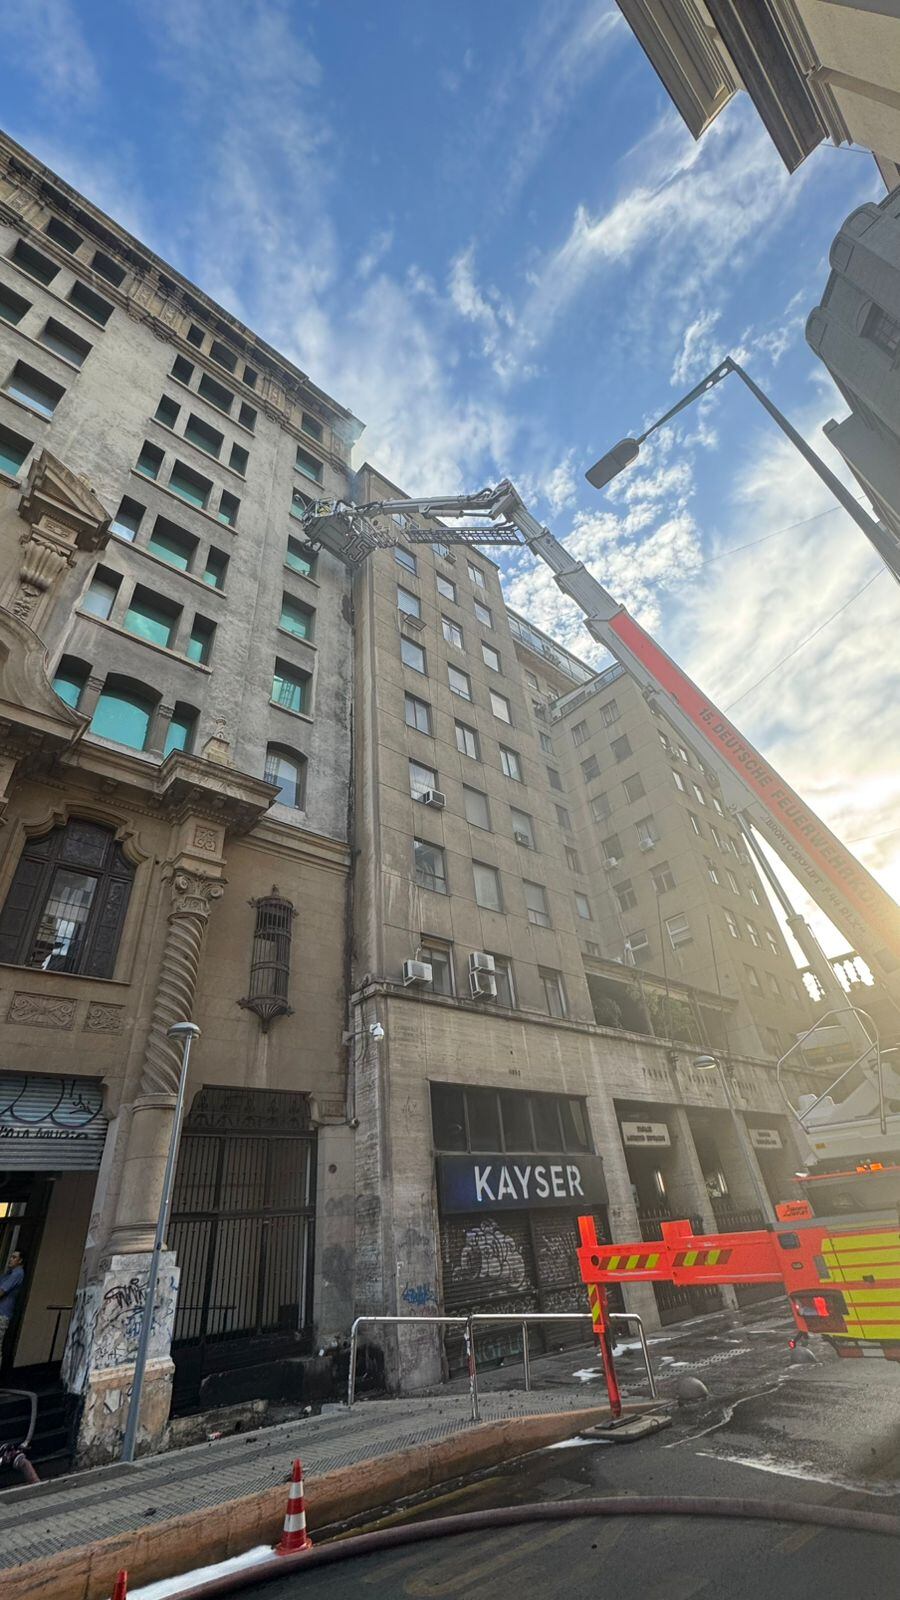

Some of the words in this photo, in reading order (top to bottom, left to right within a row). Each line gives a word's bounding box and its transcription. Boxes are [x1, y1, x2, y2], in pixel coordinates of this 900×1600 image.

[340, 535, 370, 562] 15
[712, 723, 773, 787] DEUTSCHE
[474, 1165, 584, 1202] KAYSER
